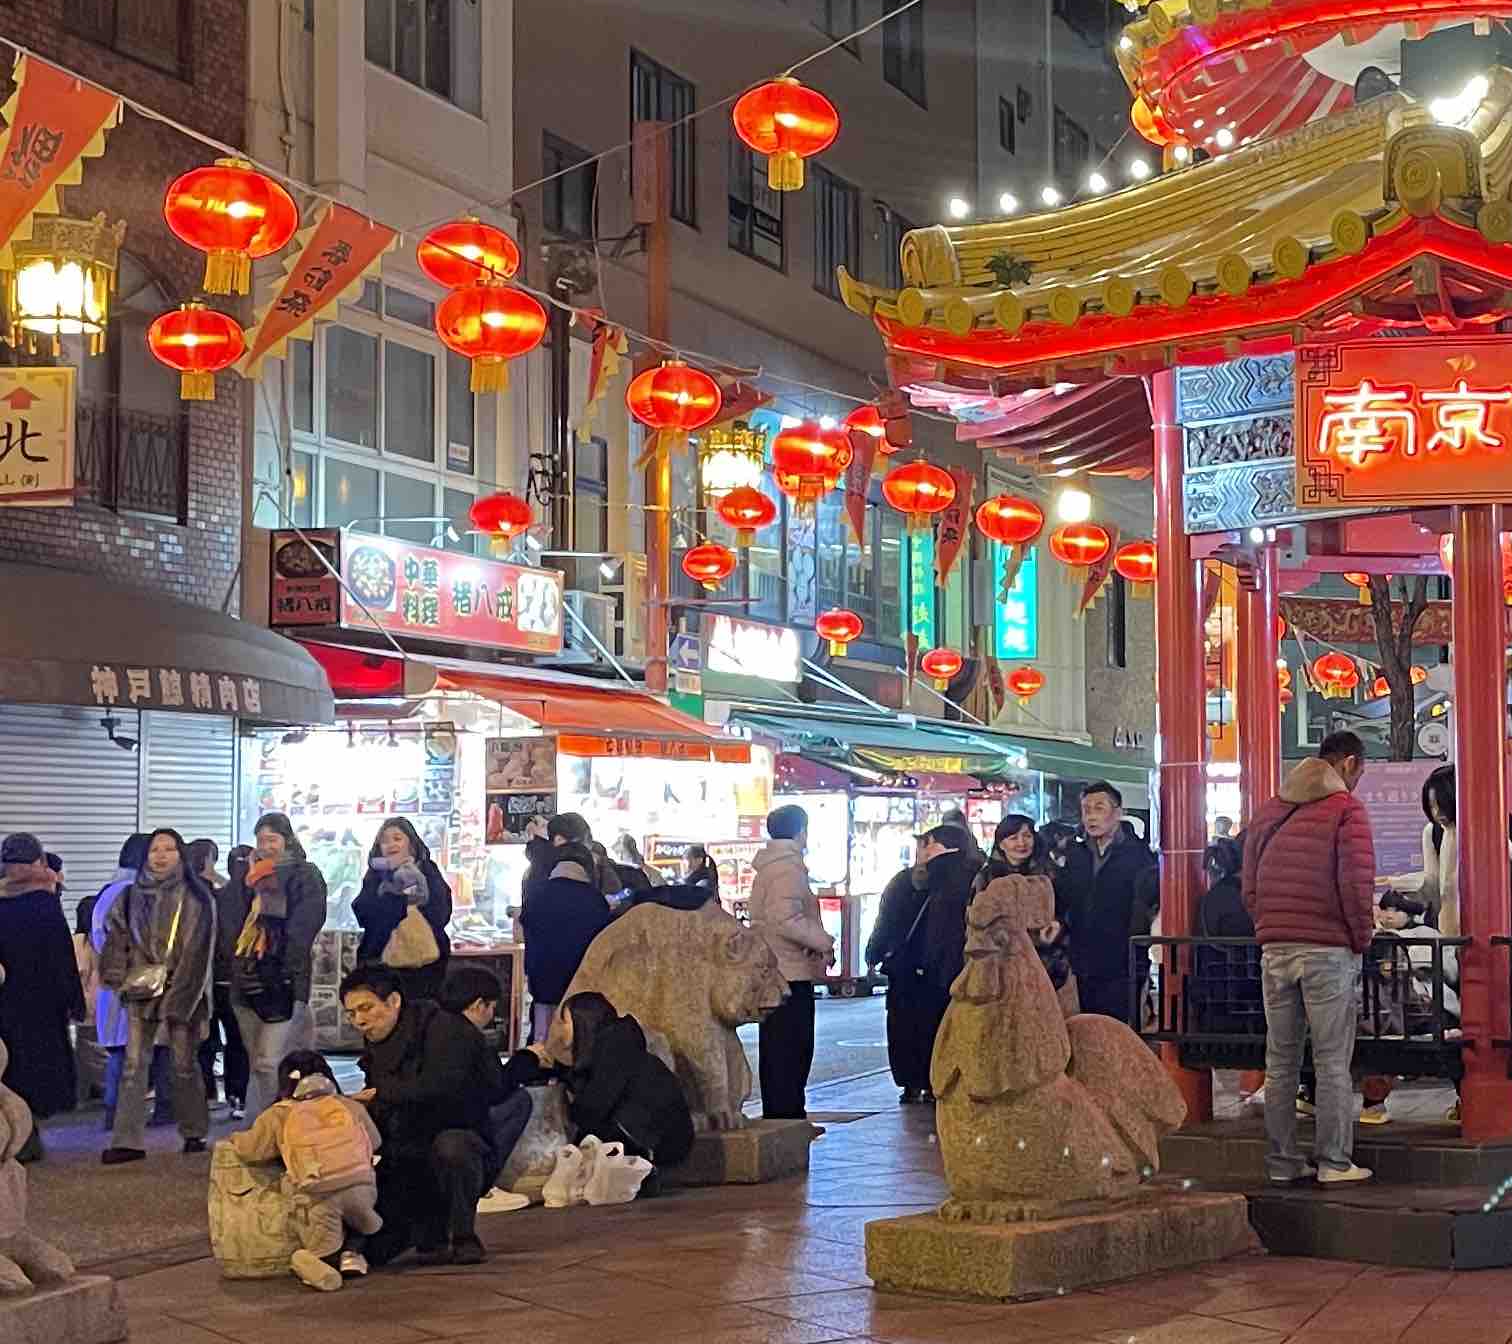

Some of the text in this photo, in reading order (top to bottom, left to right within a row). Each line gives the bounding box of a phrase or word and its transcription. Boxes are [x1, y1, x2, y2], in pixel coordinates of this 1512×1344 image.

[0, 417, 49, 463] 北
[402, 553, 440, 592] 中華
[402, 591, 440, 625] 料理
